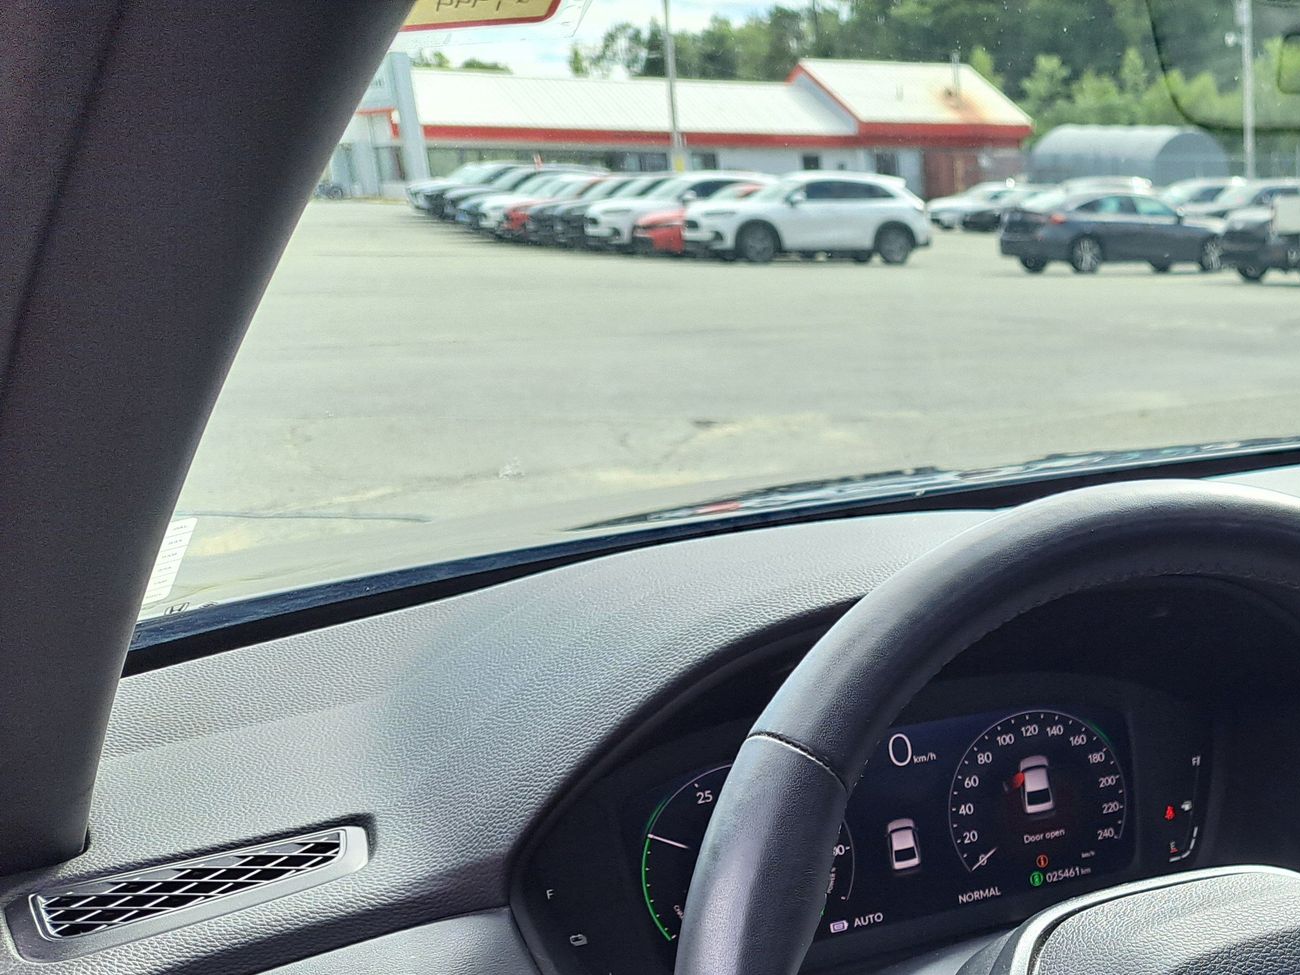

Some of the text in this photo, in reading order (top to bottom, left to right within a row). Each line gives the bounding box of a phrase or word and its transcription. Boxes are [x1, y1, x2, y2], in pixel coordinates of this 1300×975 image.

[1021, 724, 1039, 737] 120
[1046, 725, 1064, 737] 140
[996, 733, 1015, 746] 100
[1070, 734, 1087, 747] 160
[889, 733, 937, 767] 0 km/h
[977, 752, 992, 765] 80
[1088, 751, 1105, 764] 180
[964, 775, 979, 788] 60
[1098, 776, 1116, 788] 200
[697, 790, 713, 804] 25
[959, 803, 974, 816] 40
[1102, 801, 1119, 814] 220
[963, 830, 978, 844] 20
[1023, 828, 1066, 844] Door open
[1097, 827, 1114, 840] 240
[1046, 867, 1080, 882] 025461
[958, 886, 1002, 904] NORMAL
[854, 912, 884, 928] AUTO
